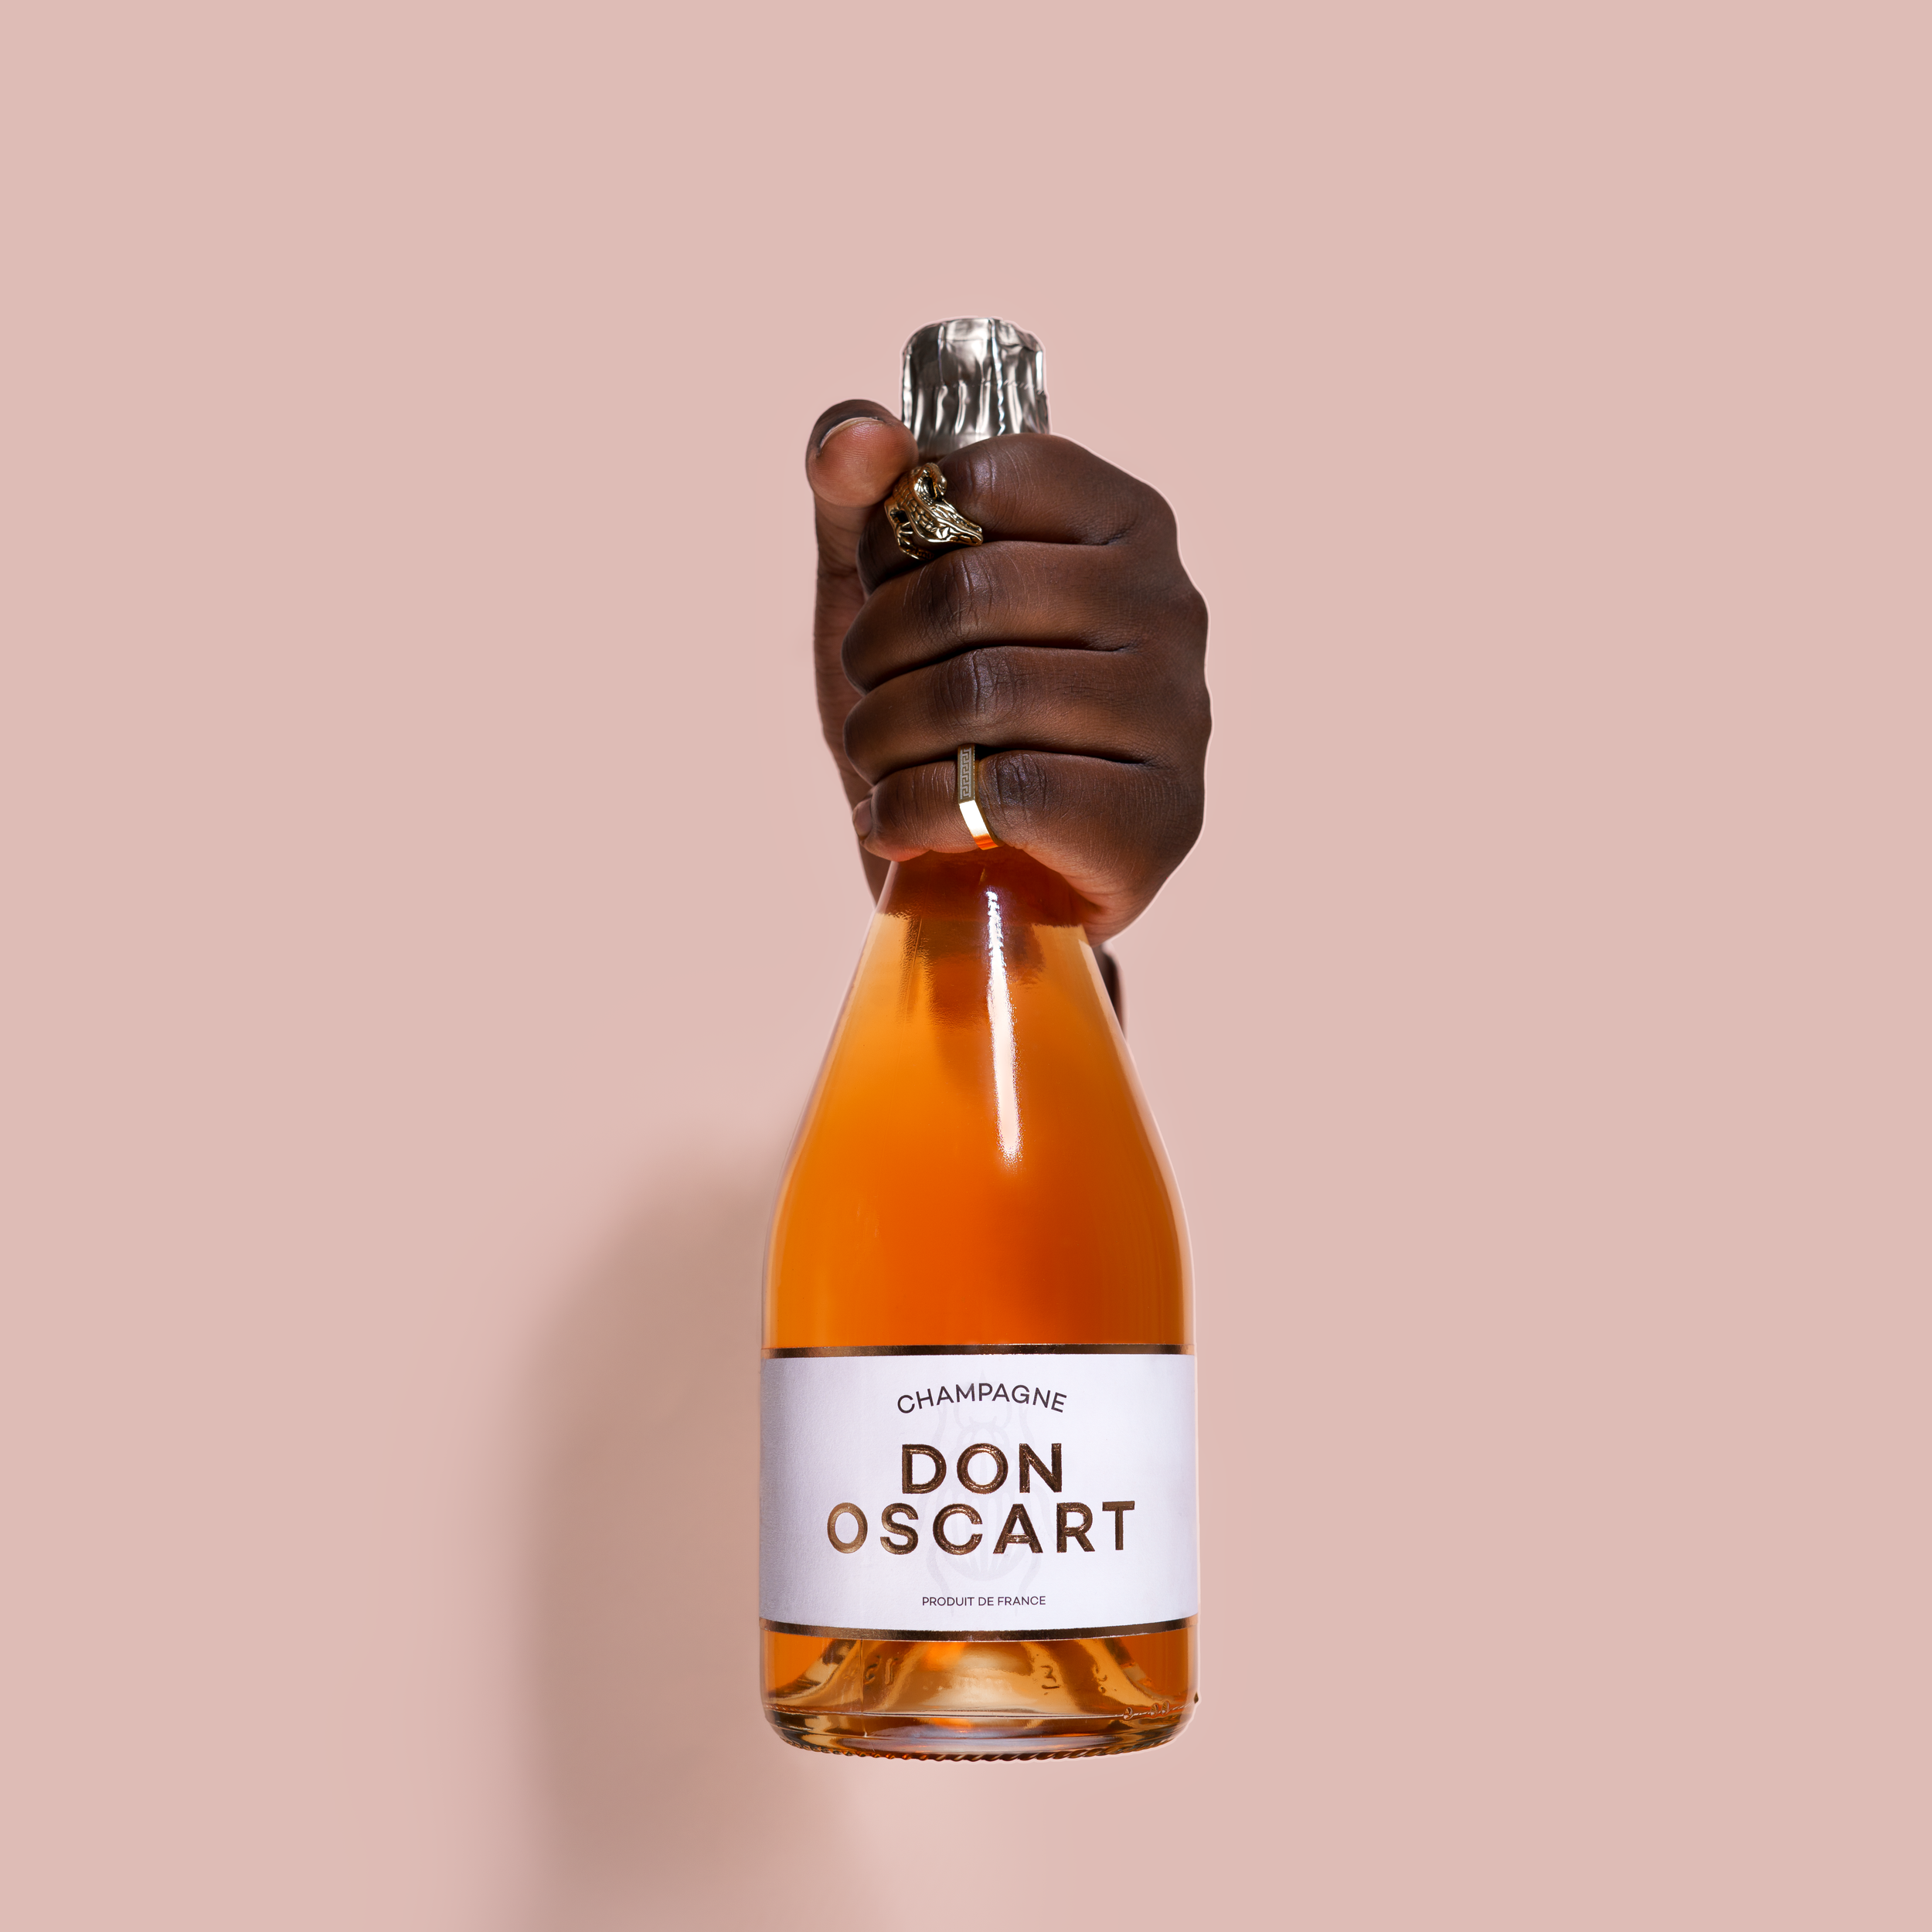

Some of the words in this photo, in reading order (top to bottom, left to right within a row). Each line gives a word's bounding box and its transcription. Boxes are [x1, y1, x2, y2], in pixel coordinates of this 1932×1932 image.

[896, 1383, 1067, 1414] CHAMPAGNE
[901, 1443, 1063, 1495] DON
[826, 1500, 1136, 1556] OSCART
[921, 1596, 975, 1607] PRODUIT
[978, 1596, 995, 1607] DE
[997, 1595, 1047, 1606] FRANCE
